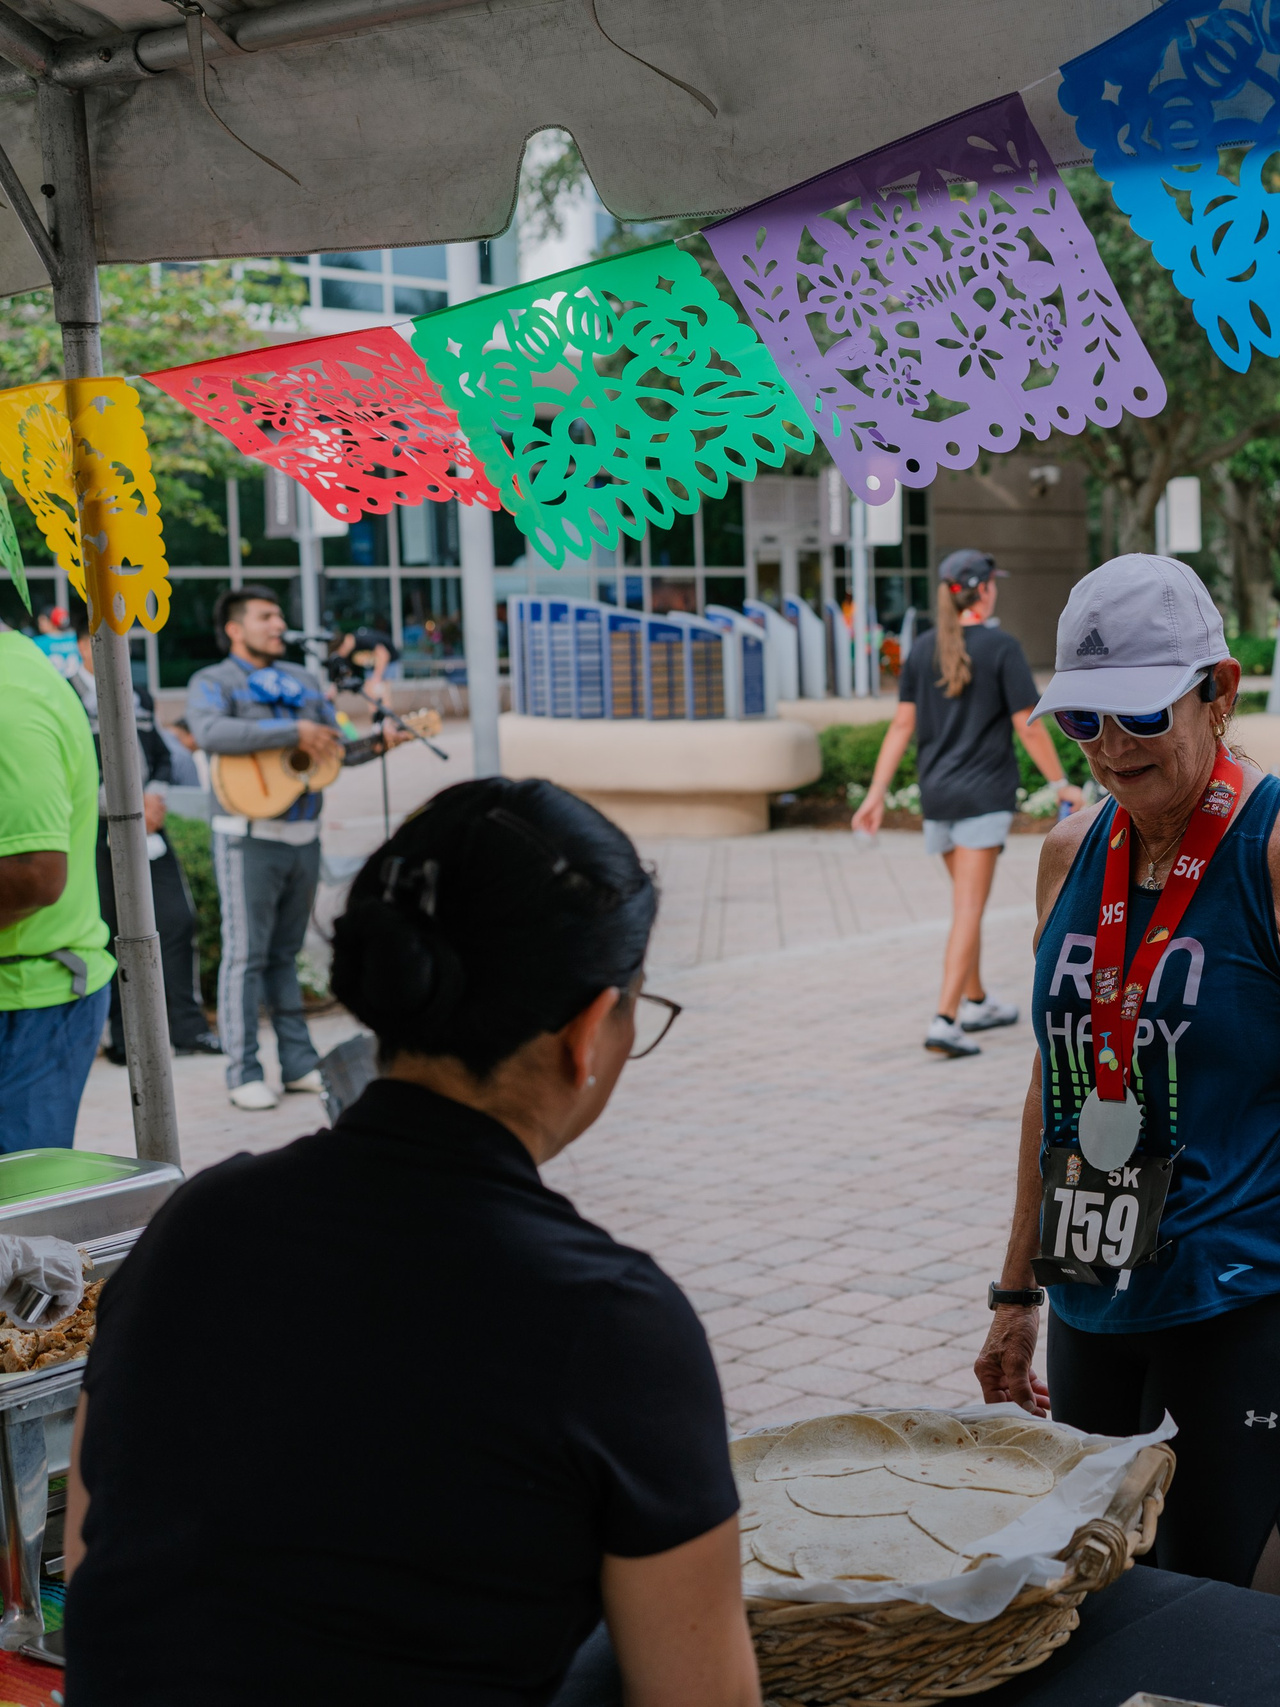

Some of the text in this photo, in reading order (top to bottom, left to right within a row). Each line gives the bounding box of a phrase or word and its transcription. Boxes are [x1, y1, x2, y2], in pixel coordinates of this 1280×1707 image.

[1076, 647, 1109, 656] adidas
[1173, 855, 1206, 880] 5K
[1101, 901, 1125, 926] 5K
[1049, 933, 1205, 1006] RN
[1046, 1011, 1192, 1081] HAPY
[1107, 1166, 1142, 1188] 5K
[1054, 1187, 1139, 1267] 759
